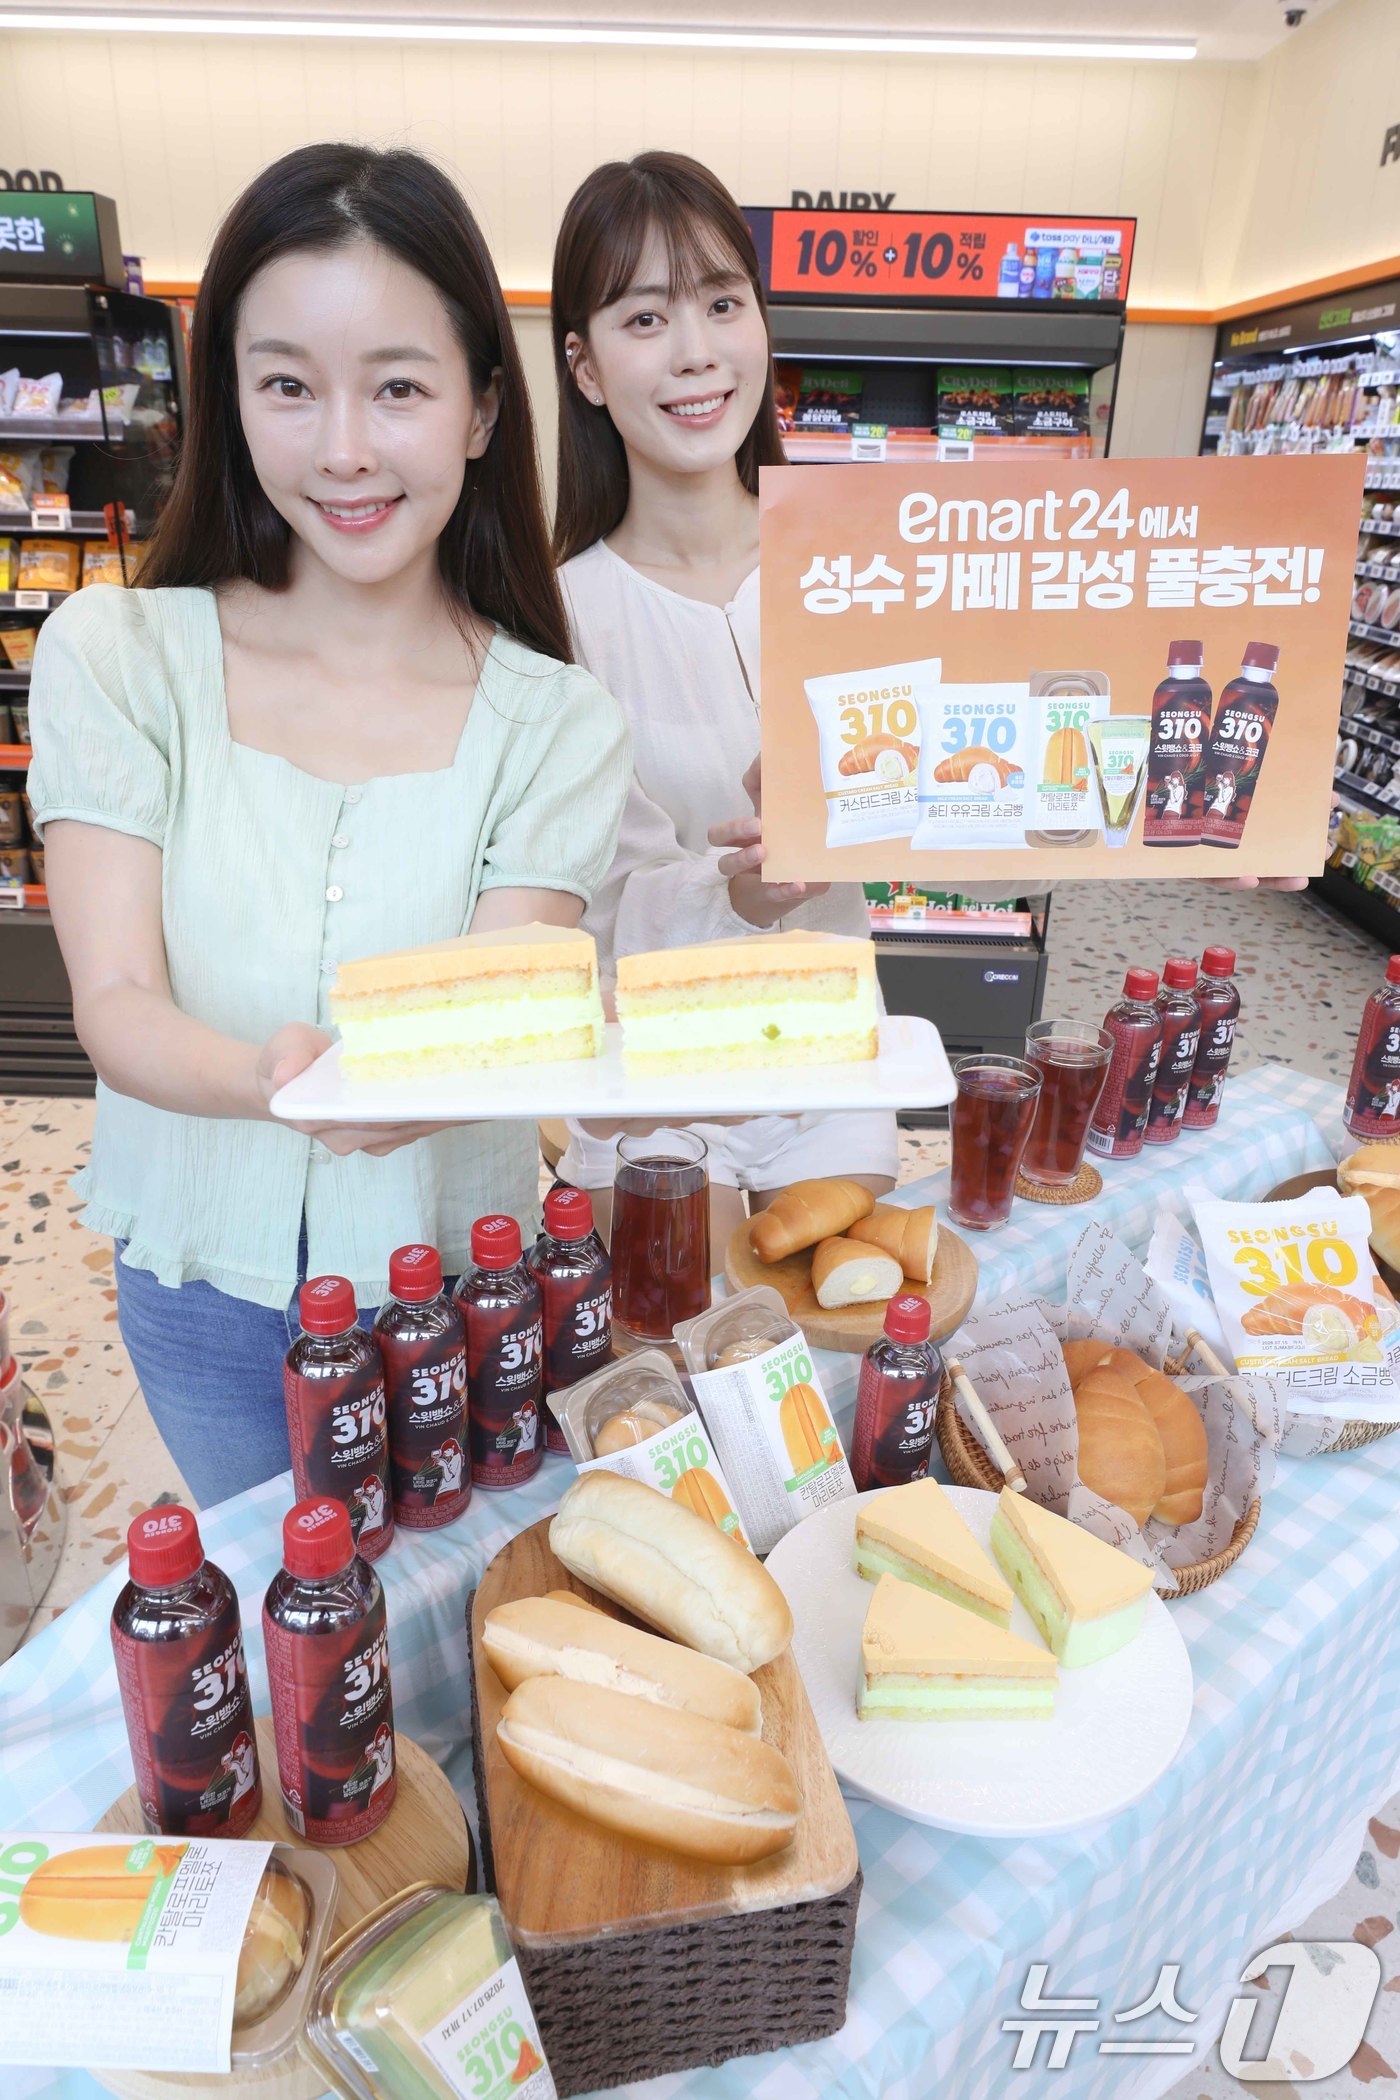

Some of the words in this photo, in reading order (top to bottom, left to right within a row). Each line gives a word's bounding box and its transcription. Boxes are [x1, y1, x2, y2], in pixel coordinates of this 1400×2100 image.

[792, 191, 896, 210] DAIRY
[853, 230, 879, 247] 할인
[959, 232, 986, 249] 적립
[1042, 233, 1061, 241] toss
[942, 375, 998, 389] CityDeli
[800, 552, 905, 615] 성수
[916, 548, 1021, 612] 카페
[1031, 547, 1135, 610] 감성
[1146, 545, 1325, 609] 풀충전!
[838, 685, 912, 706] SEONGSU
[1048, 702, 1090, 710] SEONGSU
[943, 704, 1016, 715] SEONGSU
[1045, 710, 1090, 732] 310
[1225, 709, 1265, 722] SEONGSU
[840, 700, 917, 745] 310
[1158, 718, 1202, 740] 310
[1219, 718, 1263, 743] 310
[940, 717, 1017, 754] 310
[1107, 755, 1135, 768] 310
[840, 790, 901, 812] 커스터드크림
[951, 803, 991, 818] 우유크림
[993, 803, 1023, 818] 소금빵
[1227, 1221, 1338, 1244] SEONGSU
[1234, 1238, 1359, 1297] 310
[500, 1325, 543, 1369] 310
[761, 1342, 804, 1373] SEONGSU
[411, 1358, 467, 1406] 310
[765, 1354, 813, 1401] 310
[1343, 1365, 1394, 1386] 소금빵
[332, 1392, 386, 1444] 310
[648, 1423, 697, 1459] SEONGSU
[654, 1436, 709, 1489] 310
[800, 1460, 847, 1500] 칸탈로프멜론
[143, 1515, 182, 1532] 310
[297, 1503, 334, 1528] 310
[193, 1640, 246, 1710] 310
[154, 1846, 208, 1946] 칸탈로프멜론
[182, 1860, 223, 1927] 마리토쪼
[461, 1978, 505, 2023] 2026.07.17
[456, 2006, 513, 2063] SEONGSU
[465, 2021, 527, 2096] 310
